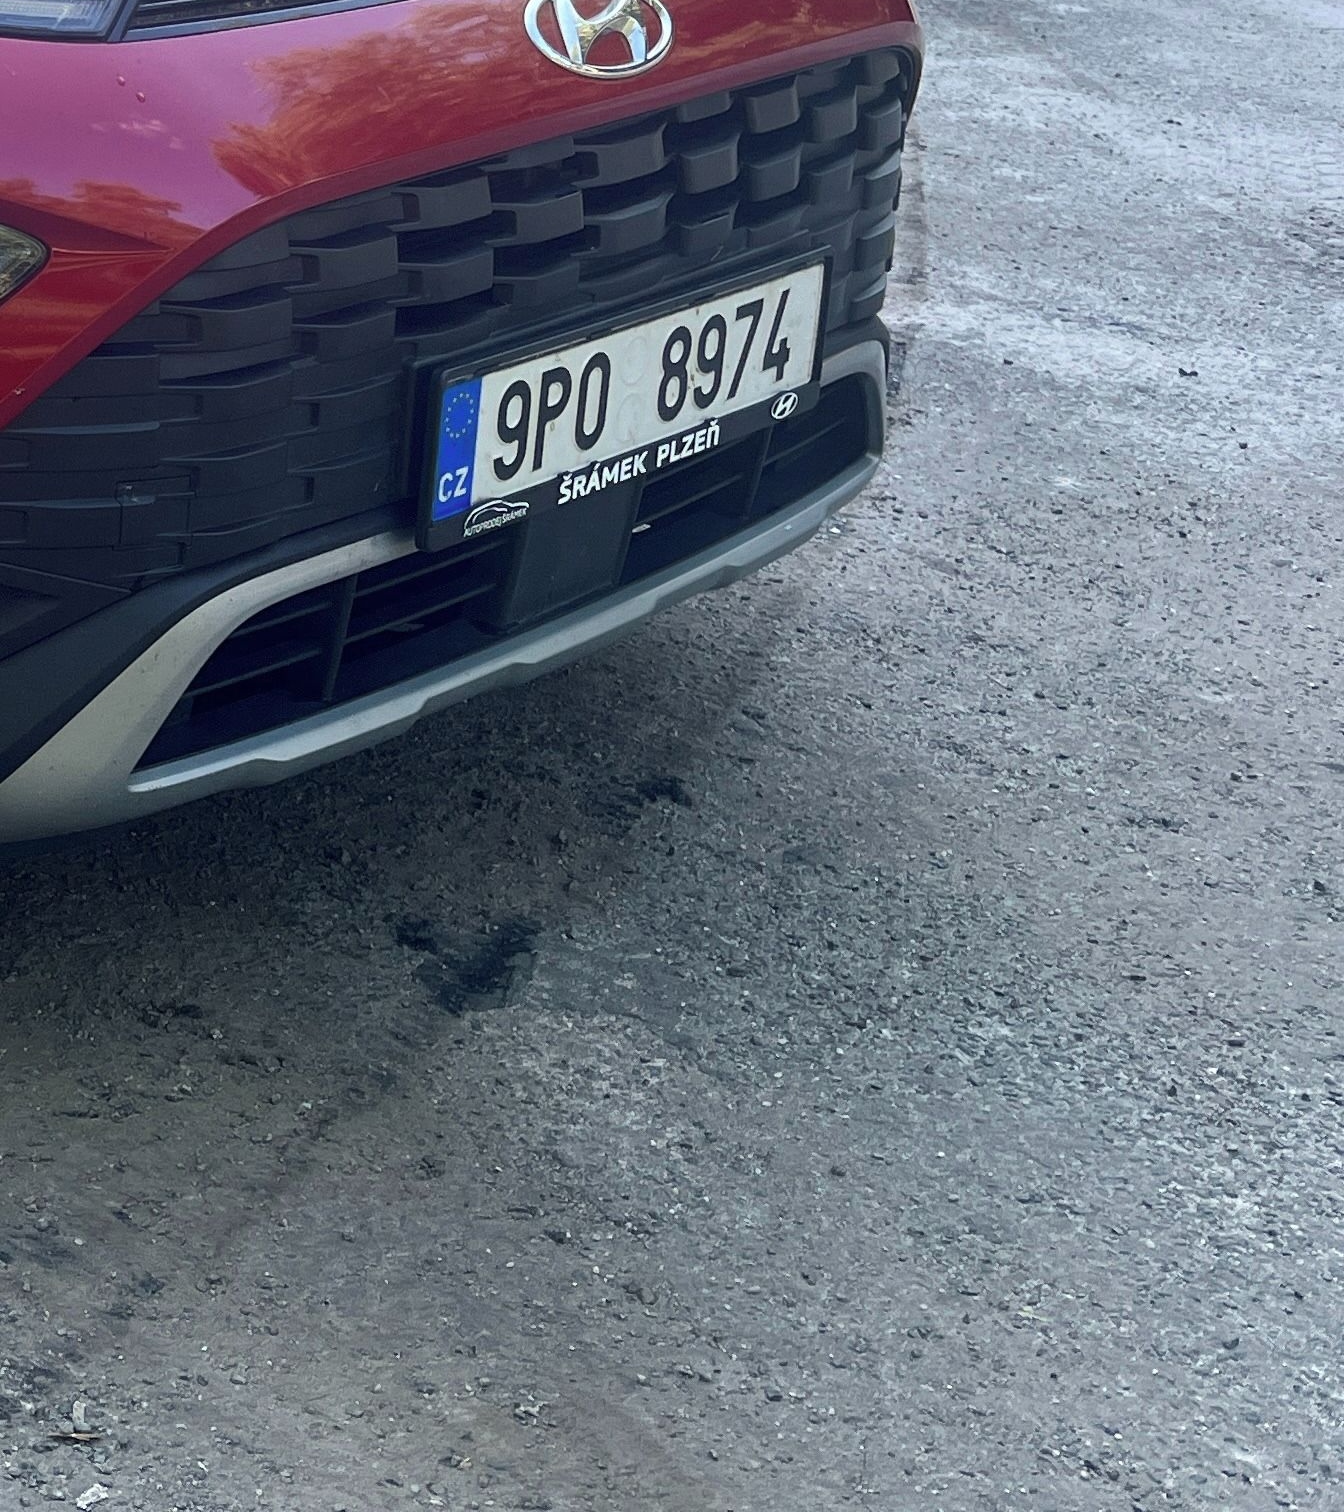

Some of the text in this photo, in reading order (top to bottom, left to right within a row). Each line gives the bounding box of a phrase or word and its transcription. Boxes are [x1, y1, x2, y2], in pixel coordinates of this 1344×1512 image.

[492, 288, 791, 481] 9P0 8974
[438, 465, 469, 503] CZ
[557, 418, 720, 505] ŠRÁMEK PLZEŇ
